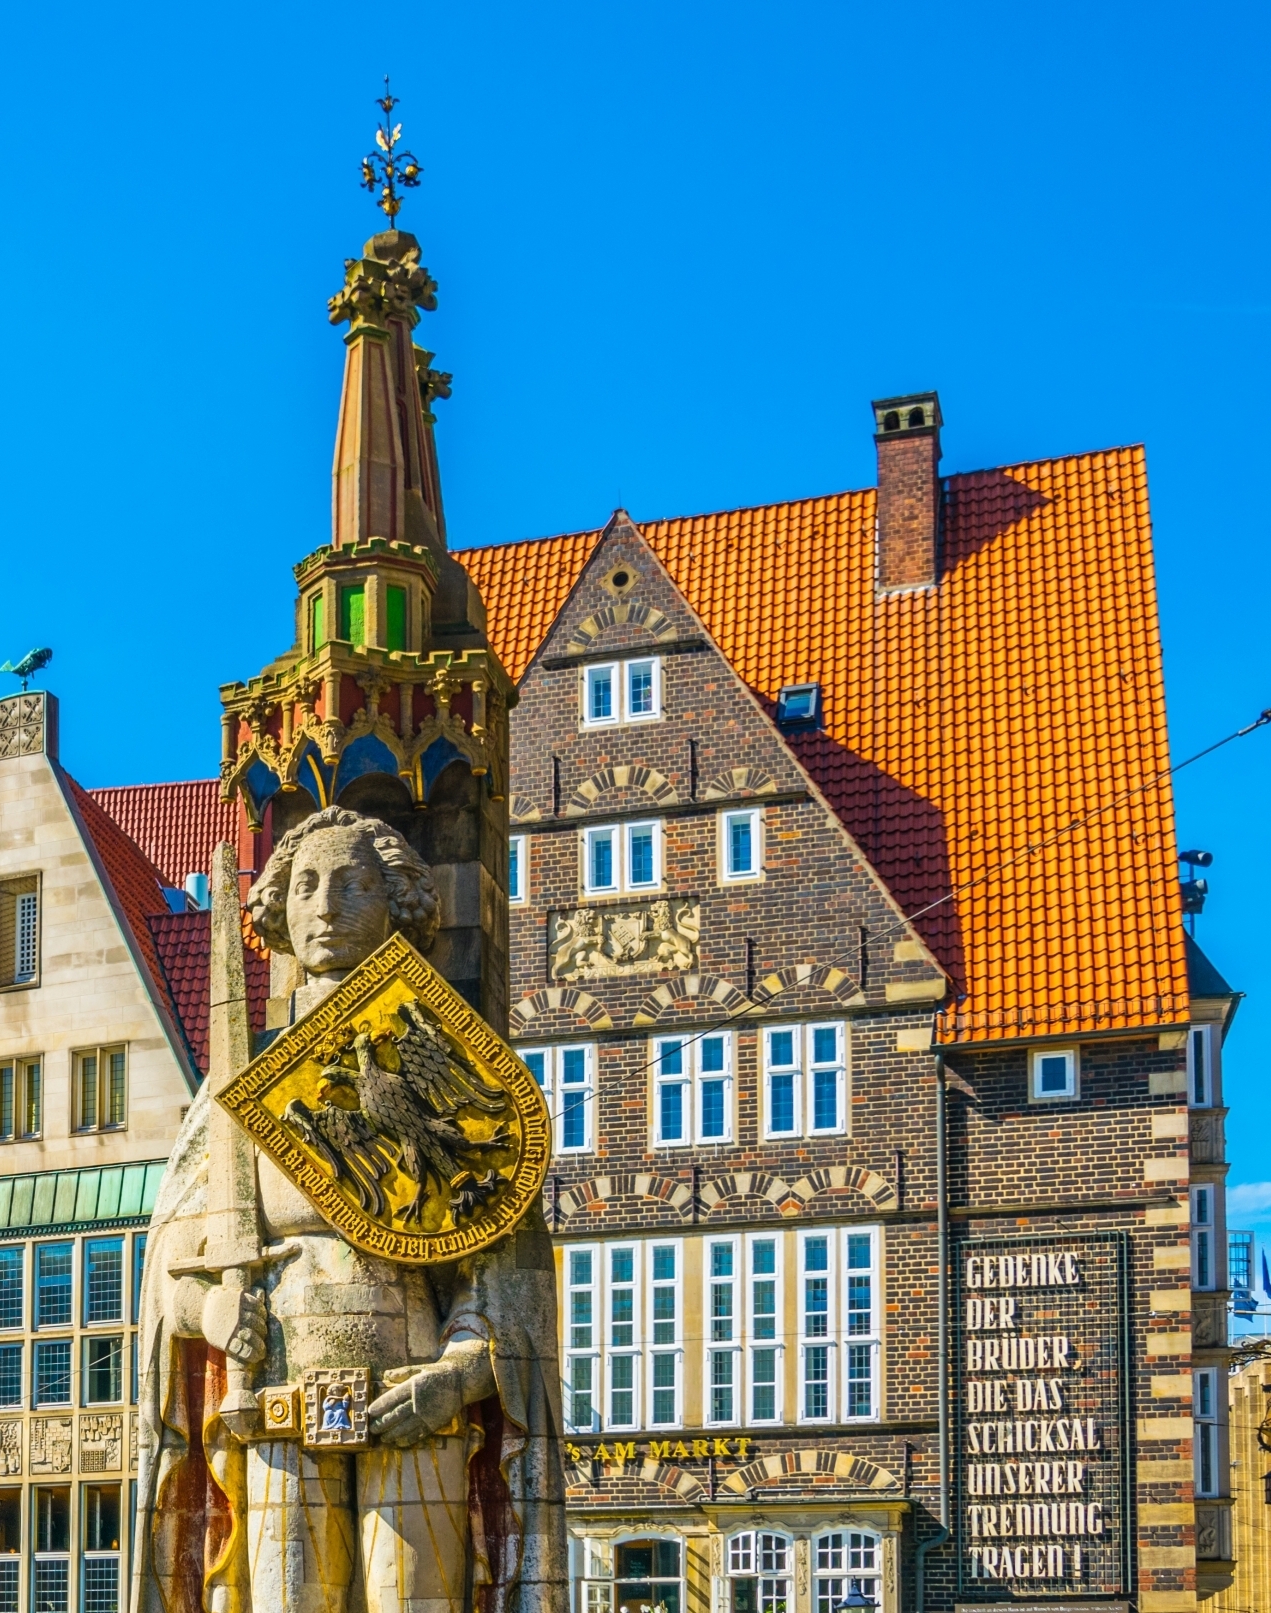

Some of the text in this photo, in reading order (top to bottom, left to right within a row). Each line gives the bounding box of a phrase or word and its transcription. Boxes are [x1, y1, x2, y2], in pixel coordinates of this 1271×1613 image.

[966, 1252, 1081, 1289] GEDENKE
[966, 1297, 1016, 1331] DER
[966, 1332, 1082, 1371] BRÜDER,
[967, 1378, 1064, 1413] DIE DAS
[593, 1441, 637, 1460] AM
[648, 1437, 752, 1459] MARKT
[967, 1418, 1101, 1454] SCHICKSAL
[967, 1461, 1083, 1495] UNSERER
[968, 1502, 1104, 1537] TRENNUNG
